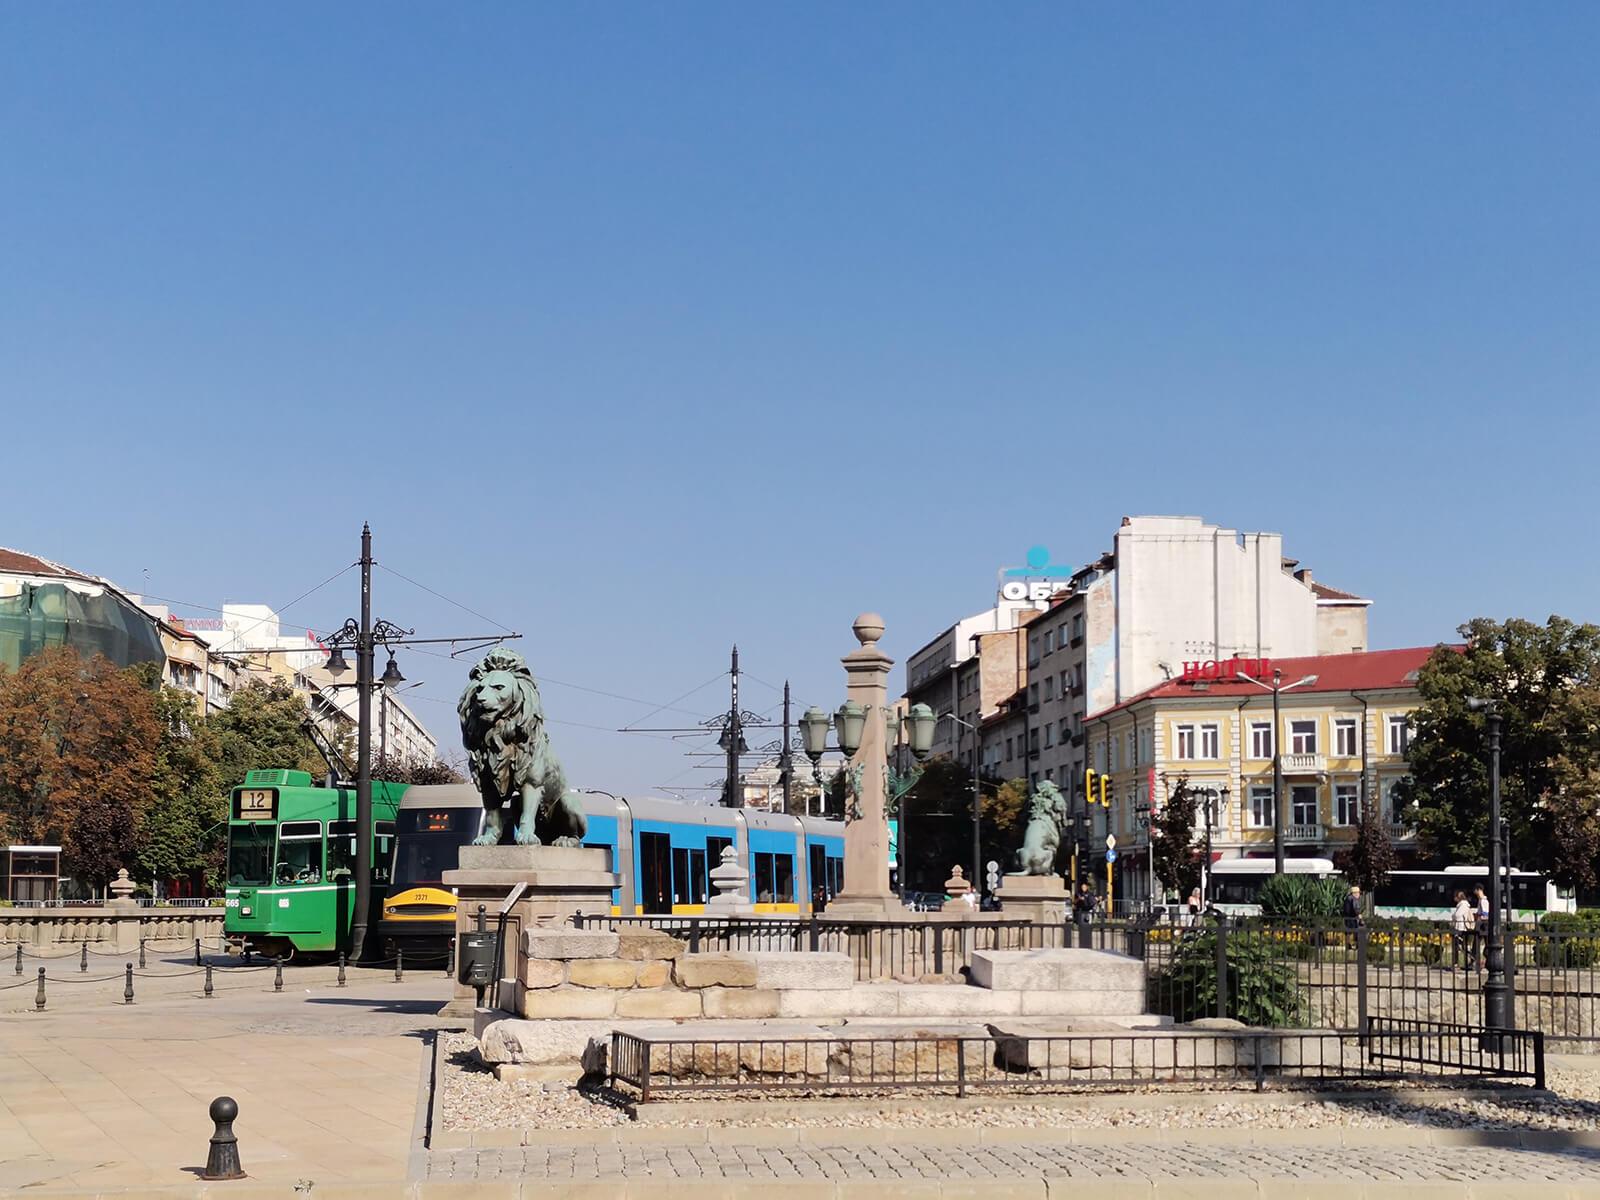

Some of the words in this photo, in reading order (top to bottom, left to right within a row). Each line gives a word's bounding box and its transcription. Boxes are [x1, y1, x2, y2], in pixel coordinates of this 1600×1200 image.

[1182, 659, 1273, 680] HOTEL
[249, 792, 265, 808] 12
[225, 898, 240, 908] 665
